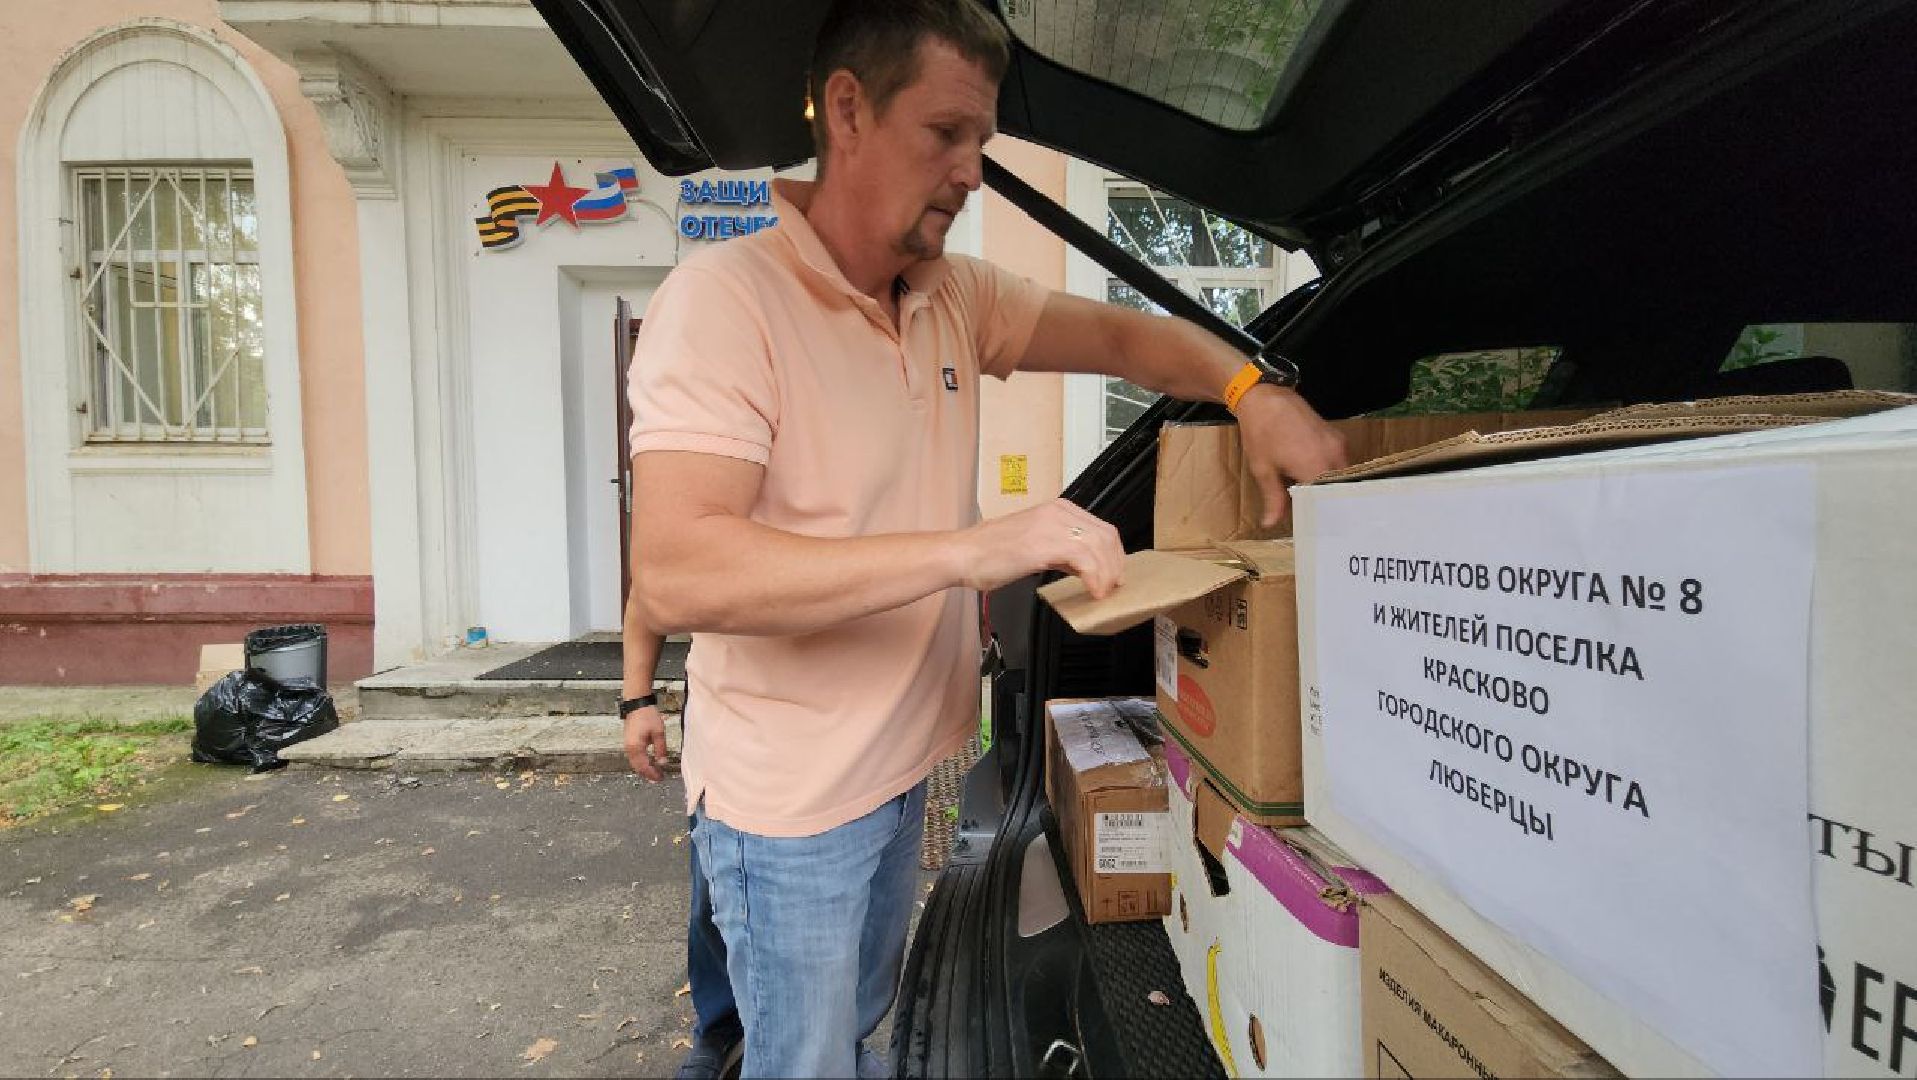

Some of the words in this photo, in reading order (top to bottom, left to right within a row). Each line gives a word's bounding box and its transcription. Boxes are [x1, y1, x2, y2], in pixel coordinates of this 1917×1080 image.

[680, 179, 769, 205] ЗАЩИ
[1348, 555, 1370, 577] ОТ
[1373, 556, 1491, 591] ДЕПУТАТОВ
[1496, 565, 1612, 606] ОКРУГА
[1679, 578, 1703, 615] 8
[1373, 602, 1386, 626] И
[1390, 605, 1488, 648] ЖИТЕЛЕЙ
[1496, 623, 1645, 681] ПОСЕЛКА
[1423, 655, 1549, 715] КРАСКОВО
[1377, 689, 1513, 763] ГОРОДСКОГО
[1520, 744, 1651, 819] ОКРУГА
[1429, 759, 1555, 841] ЛЮБЕРЦЫ
[1379, 966, 1422, 1016] ИЗДЕЛИЯ
[1423, 1009, 1500, 1080] МАКАРОННЫ
